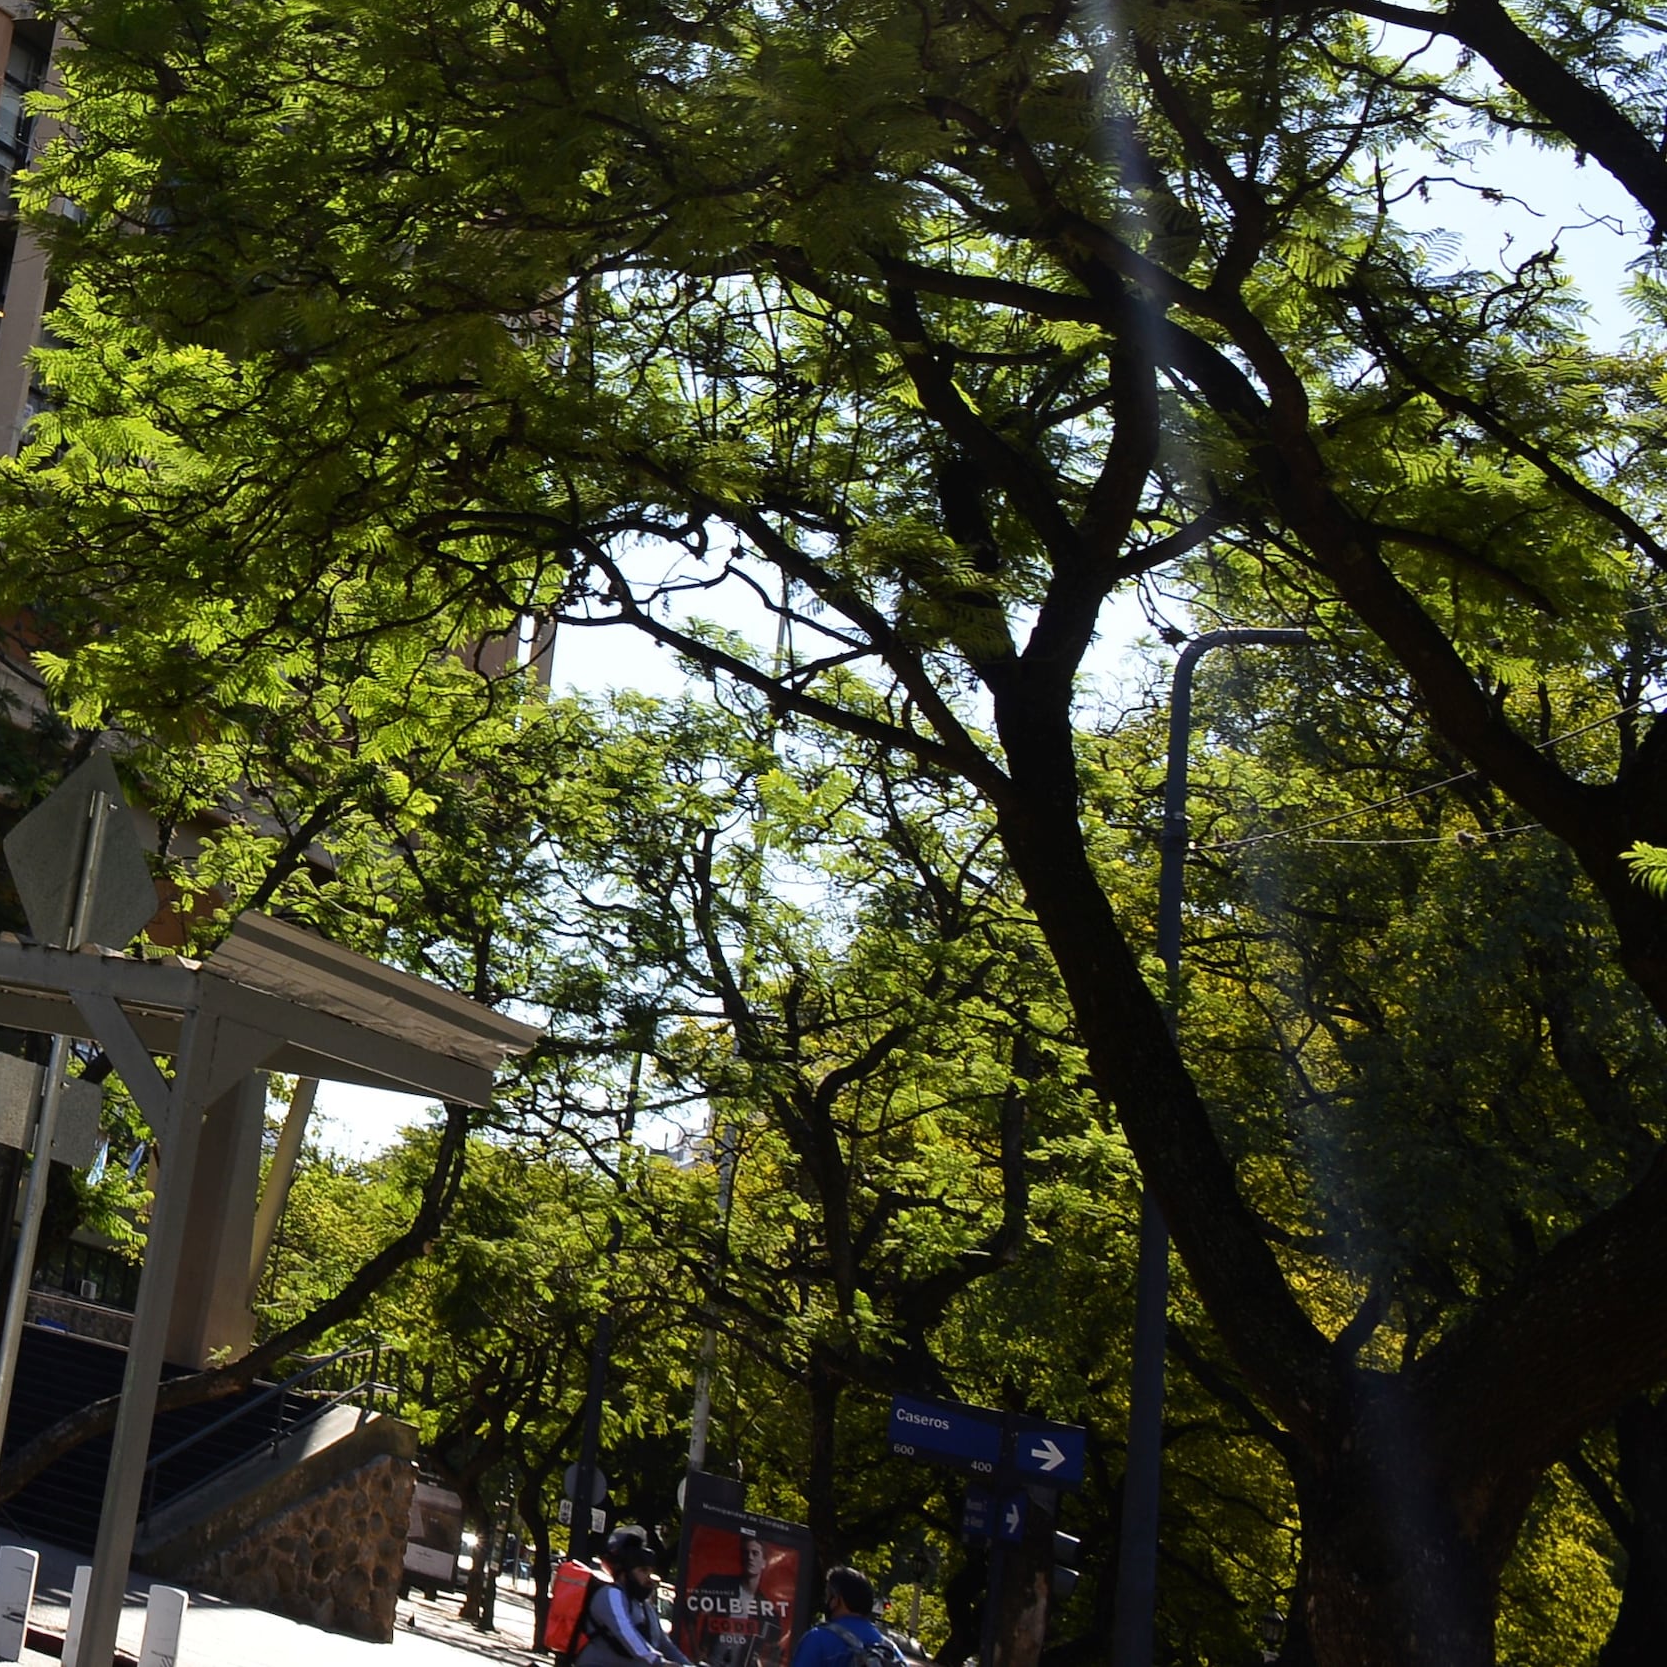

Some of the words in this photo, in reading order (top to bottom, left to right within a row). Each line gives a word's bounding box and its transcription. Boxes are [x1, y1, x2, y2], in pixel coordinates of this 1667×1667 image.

[896, 1408, 950, 1430] Caseros
[893, 1443, 915, 1456] 600
[970, 1460, 992, 1473] 400
[702, 1502, 746, 1521] Municipalidad
[749, 1514, 757, 1522] de
[687, 1595, 789, 1618] COLBERT
[719, 1634, 747, 1645] BOLD
